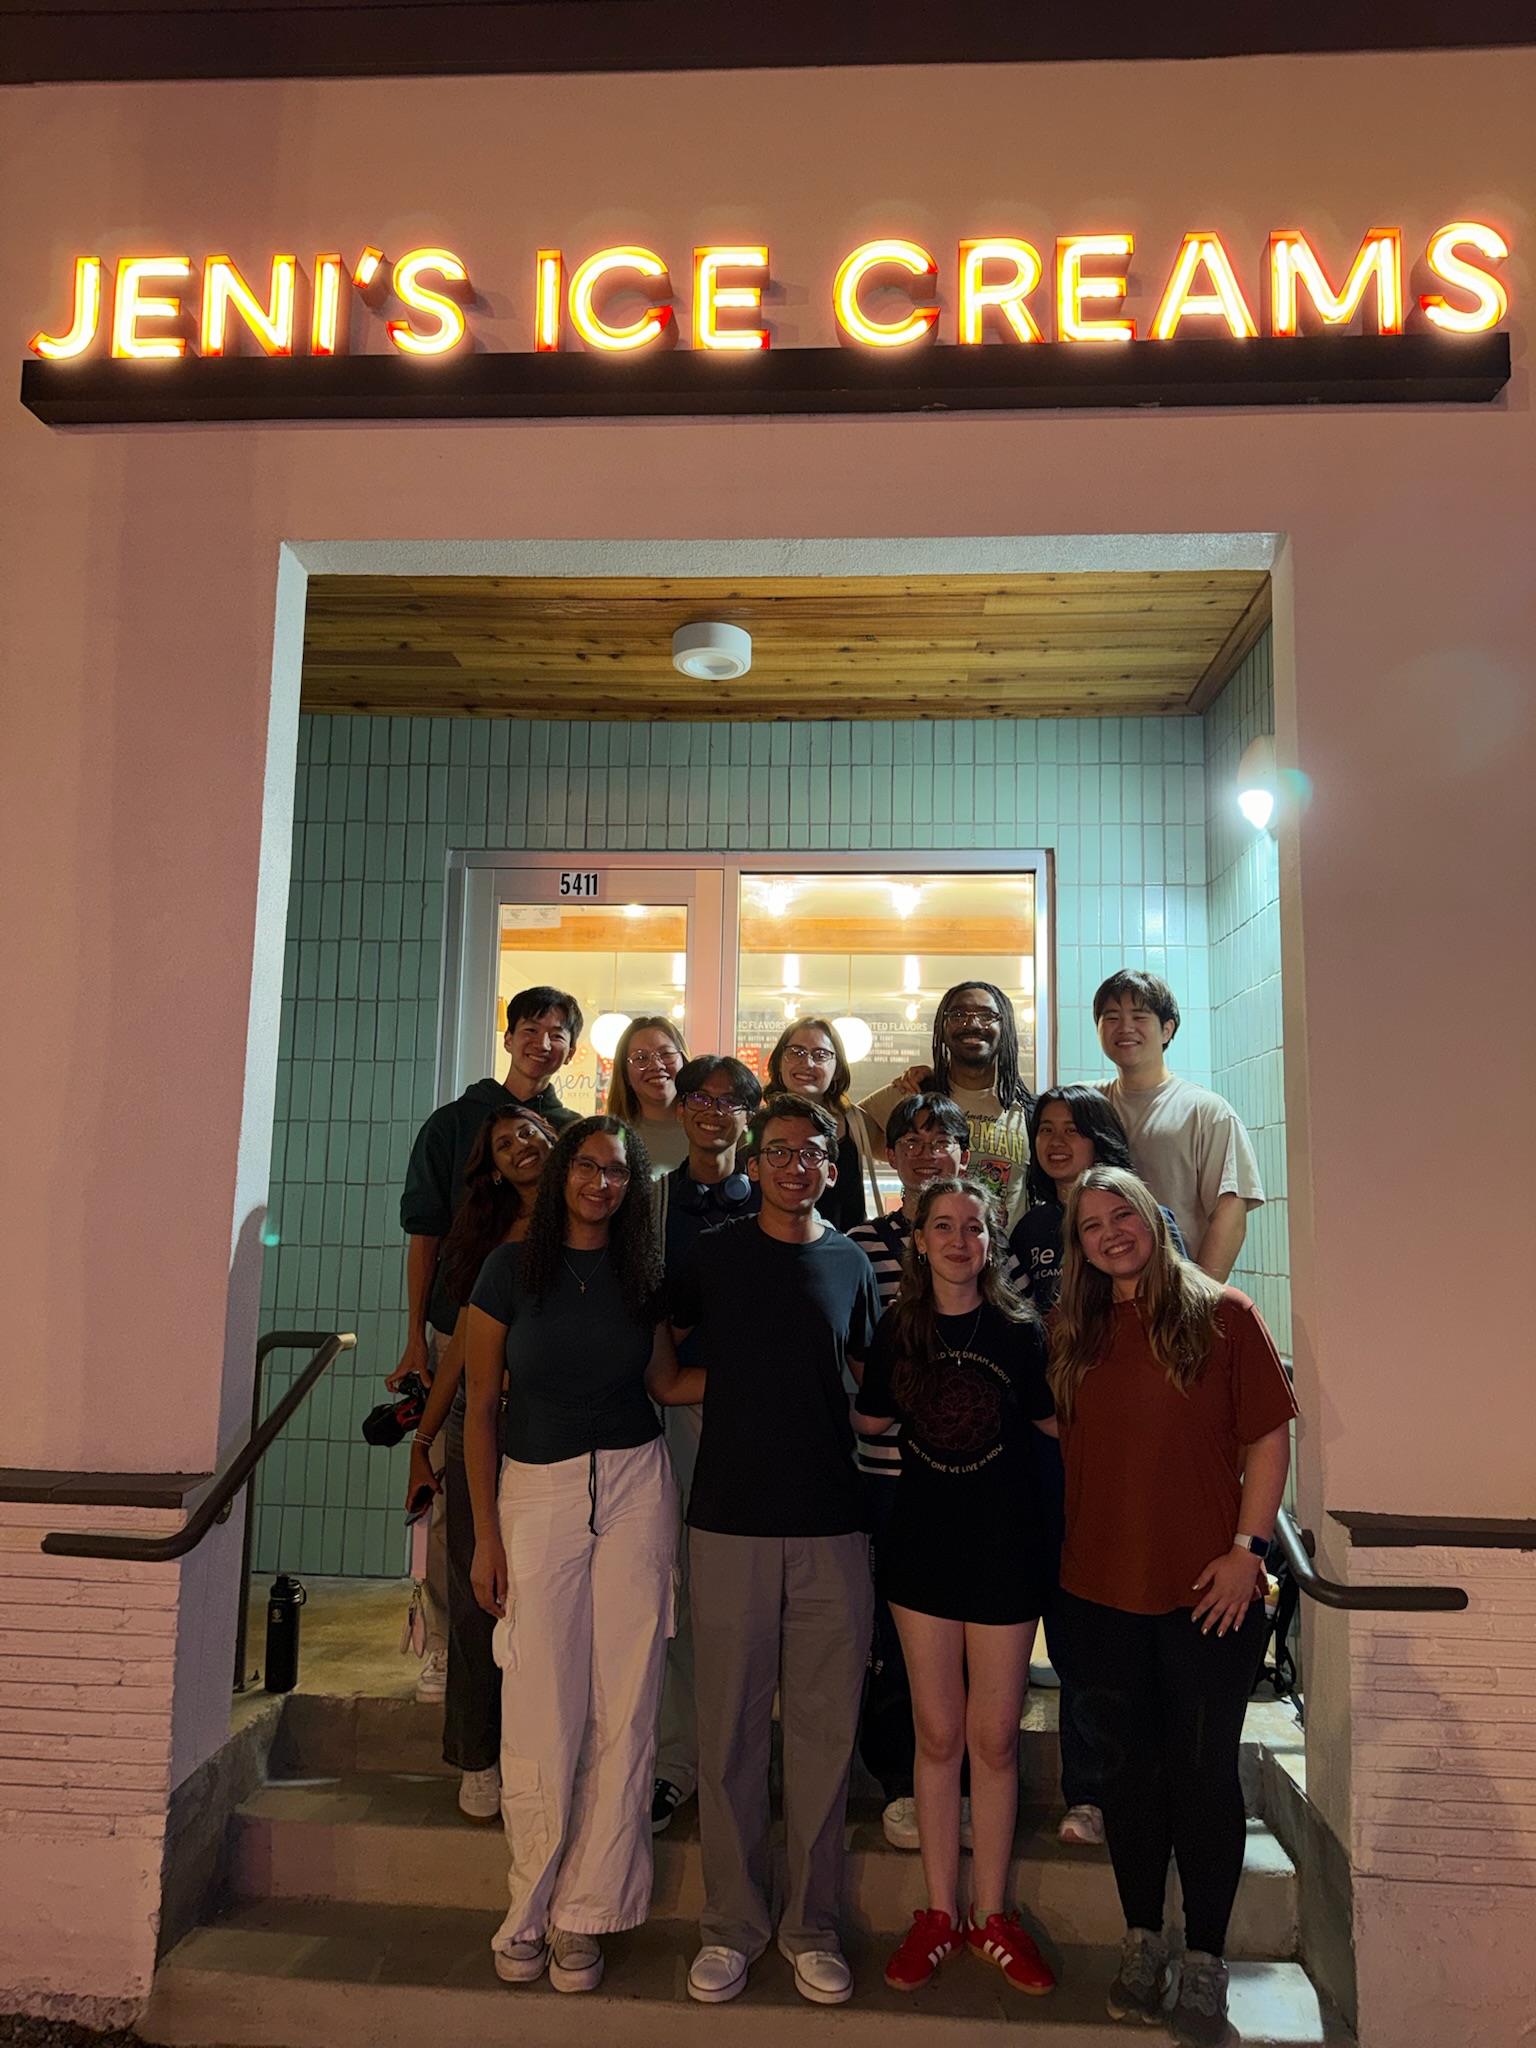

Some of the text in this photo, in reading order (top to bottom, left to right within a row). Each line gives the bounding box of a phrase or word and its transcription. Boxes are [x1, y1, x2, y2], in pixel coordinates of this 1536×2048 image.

[28, 221, 1509, 359] JENI'S ICE CREAMS
[560, 873, 598, 895] 5411
[749, 1020, 786, 1030] FLAVORS
[889, 1021, 928, 1032] FLAVORS
[966, 1119, 1024, 1166] R-MAN
[1040, 1267, 1064, 1279] CAM
[962, 1350, 990, 1366] DREAM
[908, 1440, 920, 1454] AND
[930, 1461, 947, 1473] ONE
[948, 1465, 960, 1474] WE
[961, 1462, 979, 1473] LIVE
[978, 1457, 987, 1468] IN
